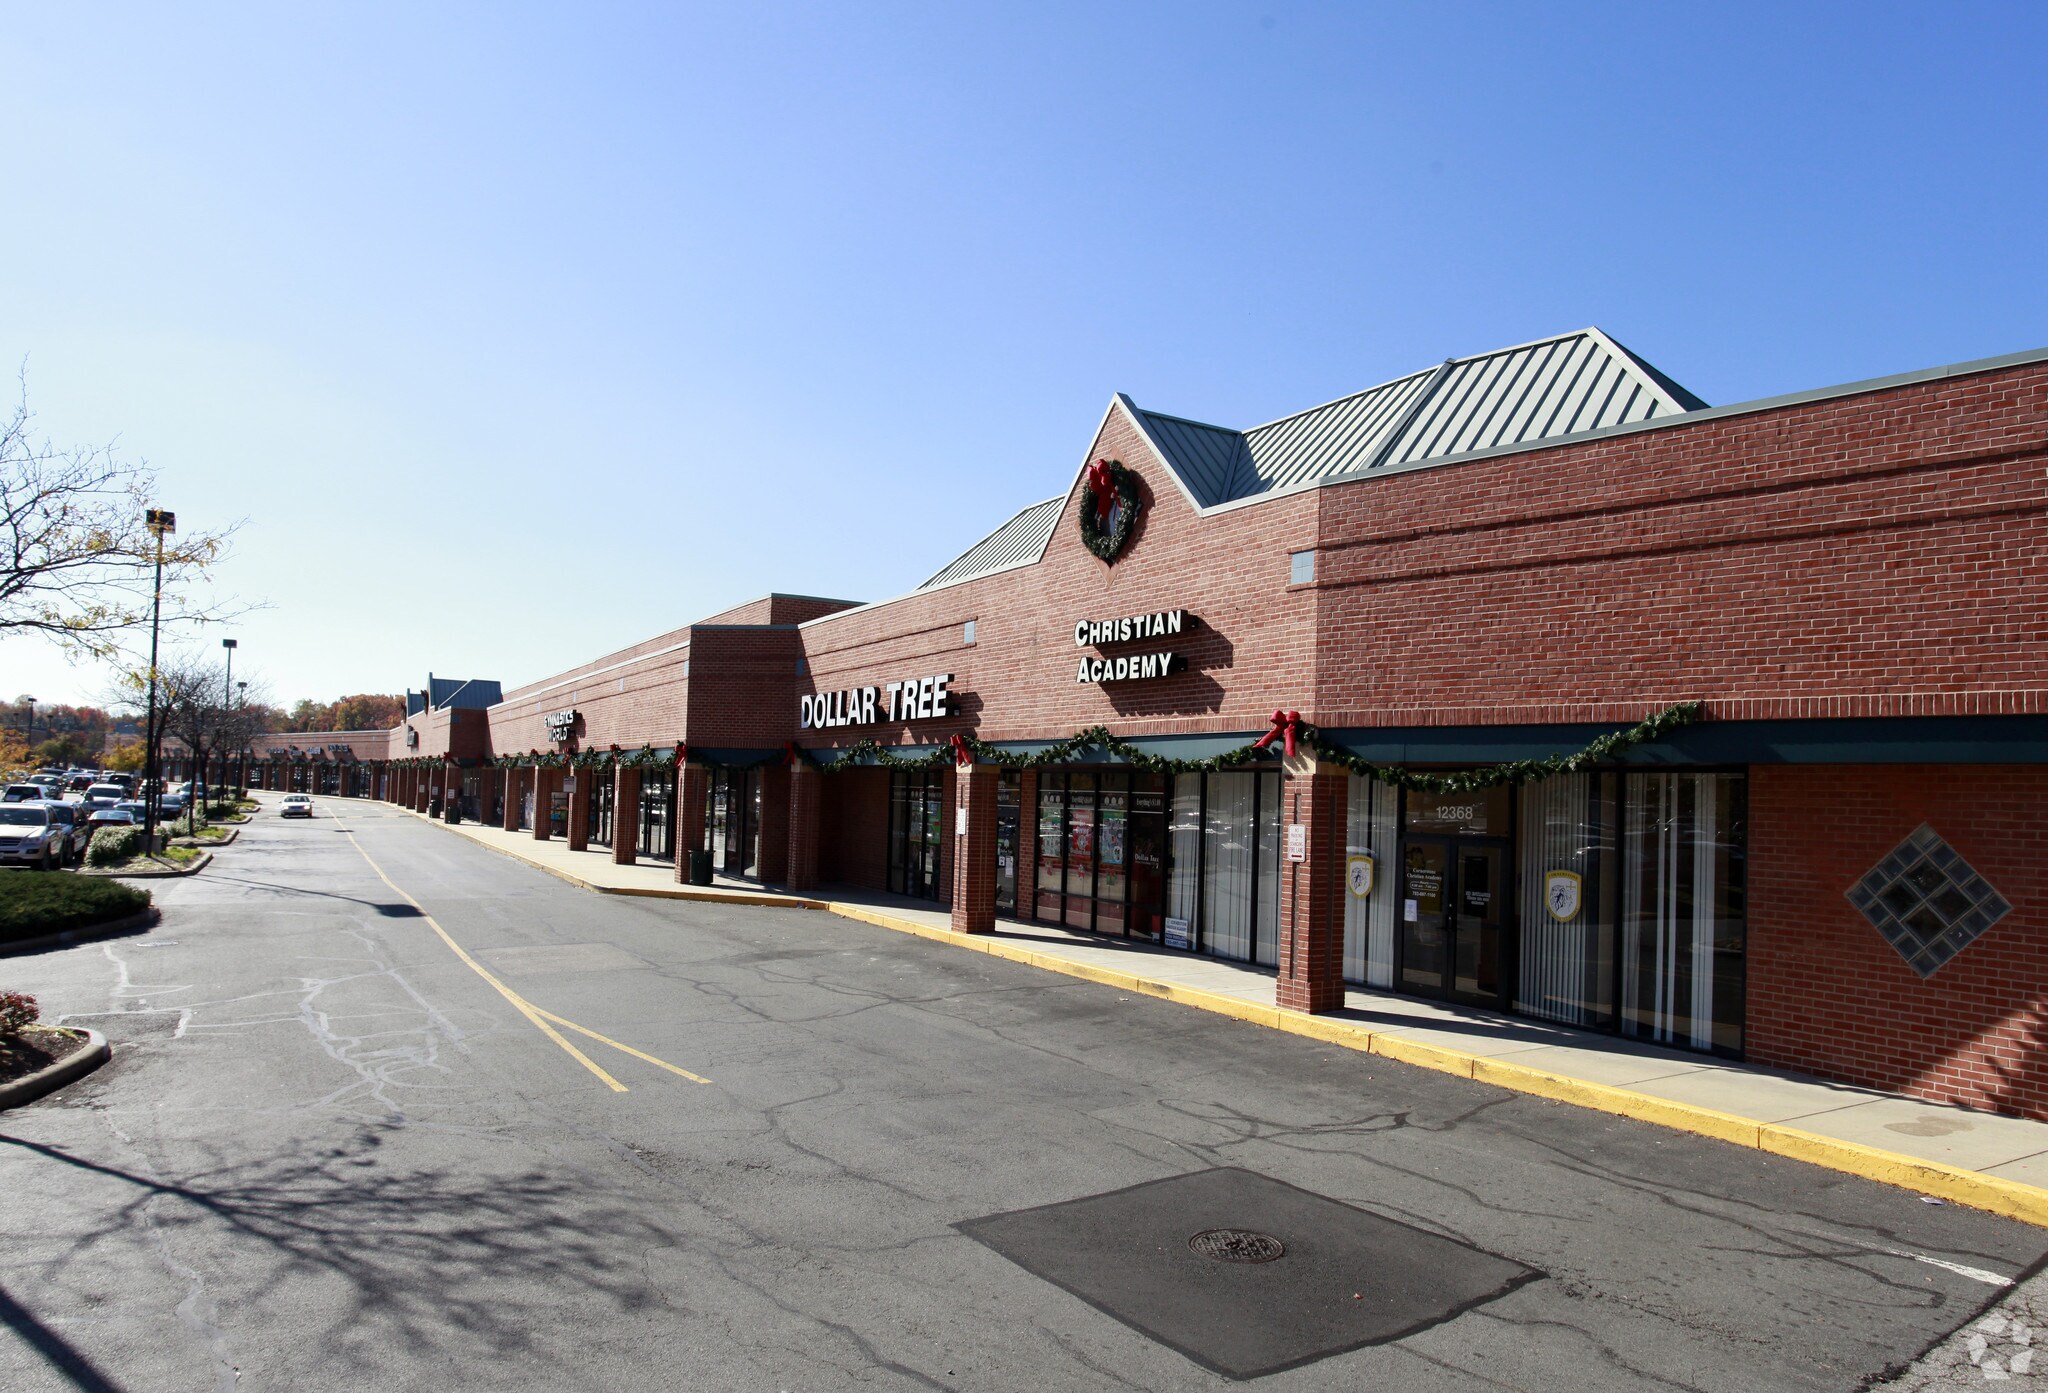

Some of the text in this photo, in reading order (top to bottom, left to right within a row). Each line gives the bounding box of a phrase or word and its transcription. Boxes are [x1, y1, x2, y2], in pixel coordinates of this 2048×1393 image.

[1075, 610, 1181, 646] CHRISTIAN
[1077, 652, 1172, 683] ACADEMY
[801, 674, 950, 729] DOLLAR TREE
[544, 709, 574, 728] GYMNASTICS
[548, 726, 568, 742] WORLD
[1436, 806, 1473, 820] 12368
